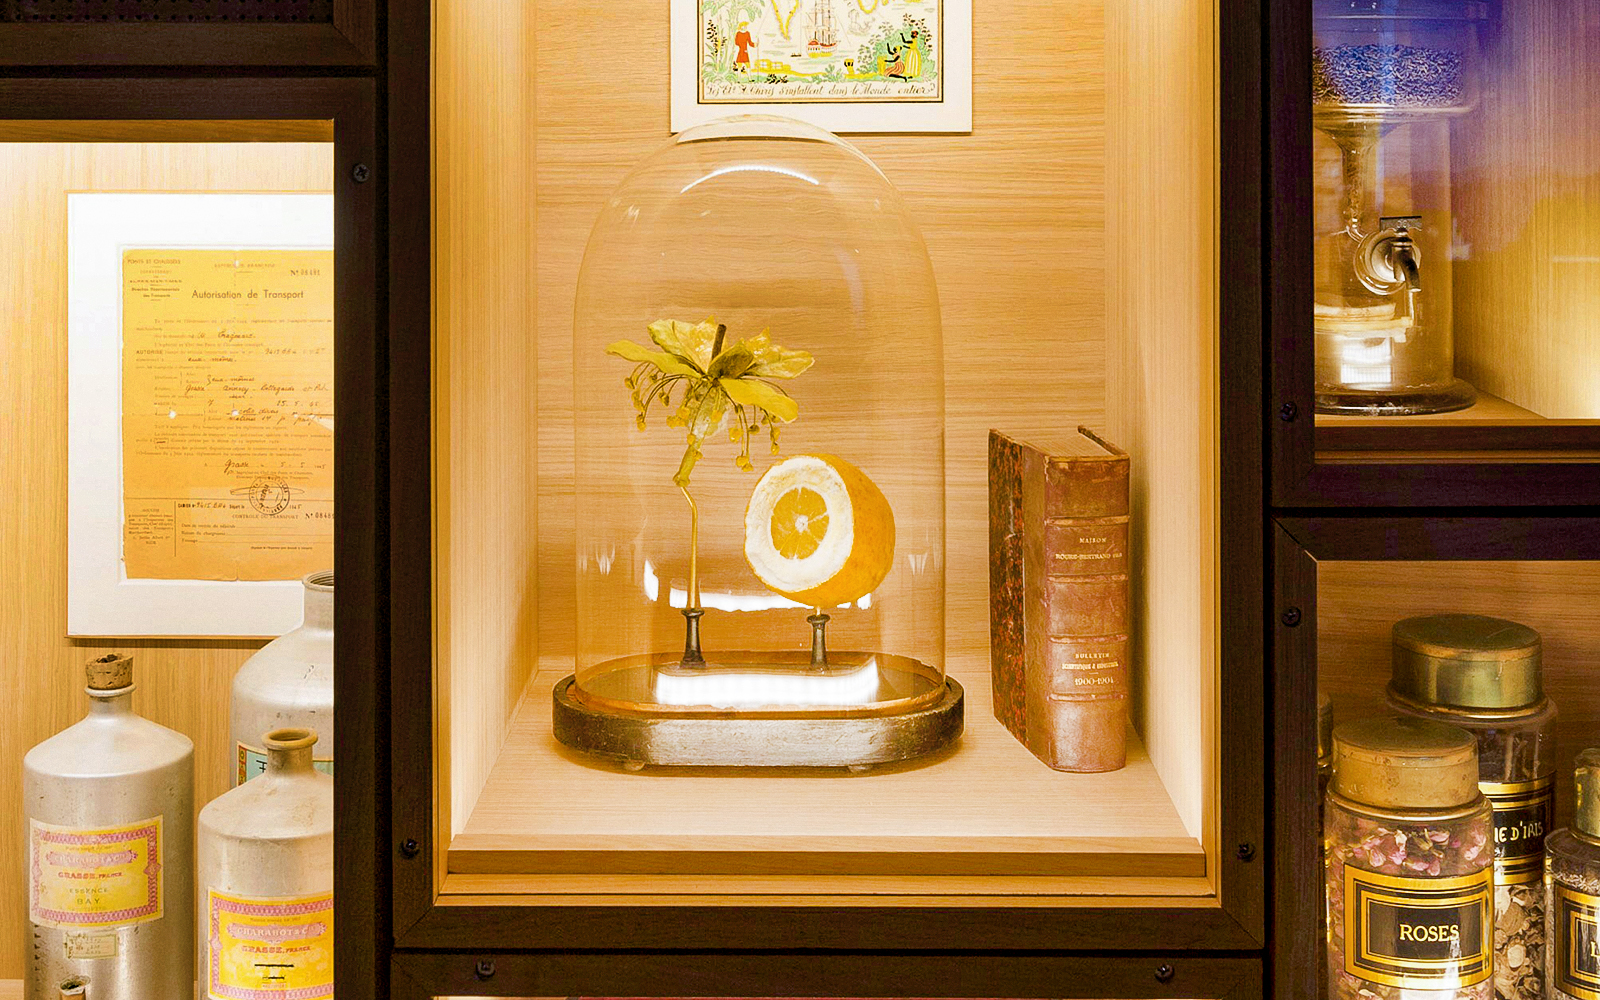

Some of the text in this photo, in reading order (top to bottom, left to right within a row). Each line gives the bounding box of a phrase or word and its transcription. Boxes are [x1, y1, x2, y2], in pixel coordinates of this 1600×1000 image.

[191, 289, 304, 300] Autorisation de Transport
[1510, 820, 1544, 842] D'IRIS
[1399, 923, 1460, 942] ROSES
